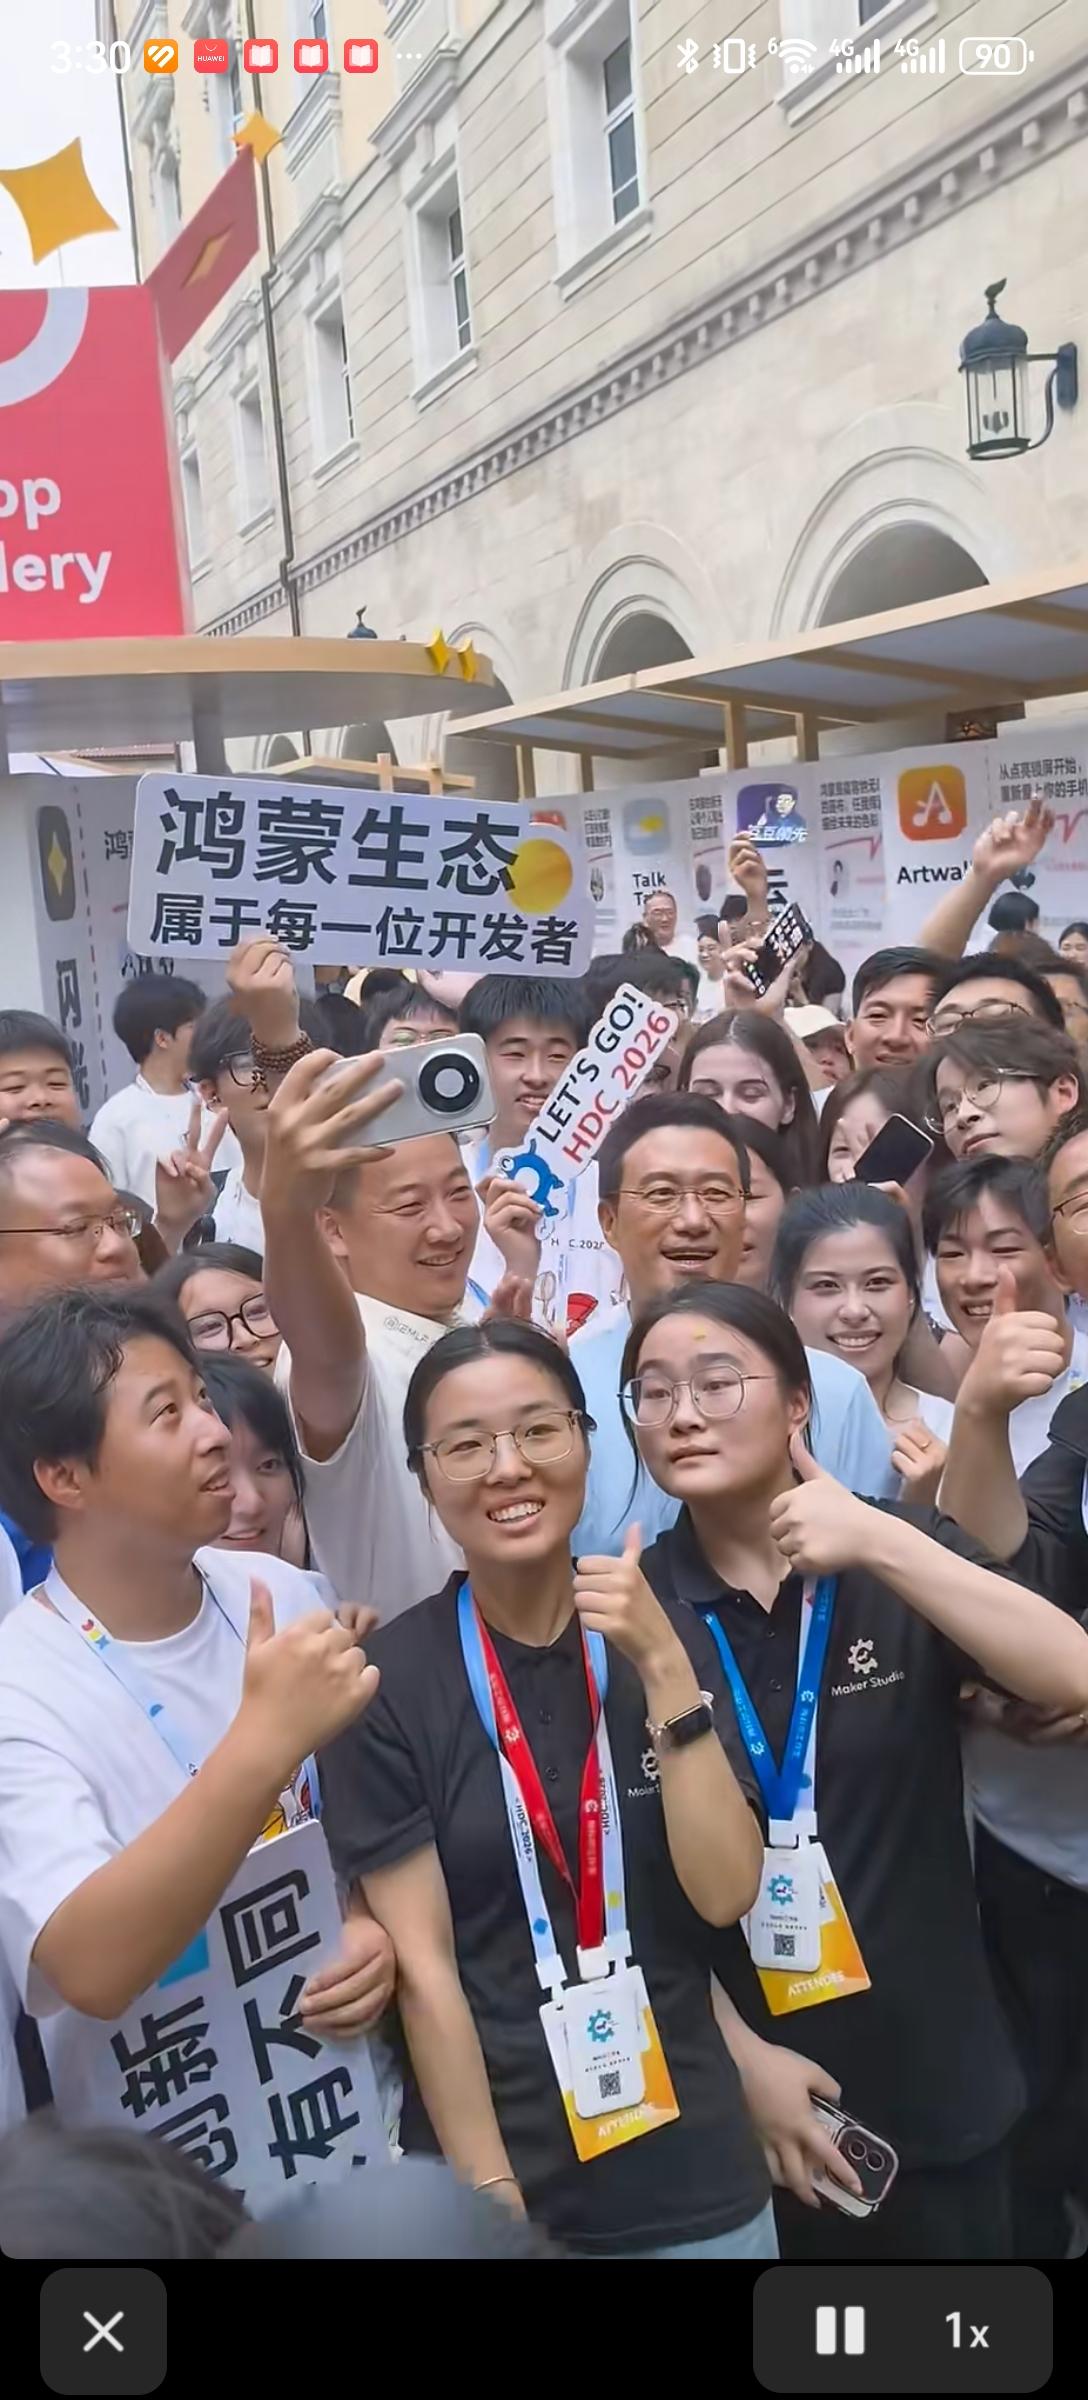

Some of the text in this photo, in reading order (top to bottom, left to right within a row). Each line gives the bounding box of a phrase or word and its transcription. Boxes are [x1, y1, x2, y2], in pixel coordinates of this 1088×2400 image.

[104, 829, 134, 861] 鸿
[156, 787, 520, 897] 鸿蒙生态
[632, 872, 667, 888] Talk
[897, 859, 973, 885] Artwal
[149, 892, 579, 966] 属于每一位开发者
[536, 991, 645, 1143] LET'S GO!
[562, 1010, 671, 1164] HDC 2026
[831, 1670, 905, 1697] Maker Studio
[219, 1868, 362, 2180] 有不同
[110, 1996, 240, 2182] 创新
